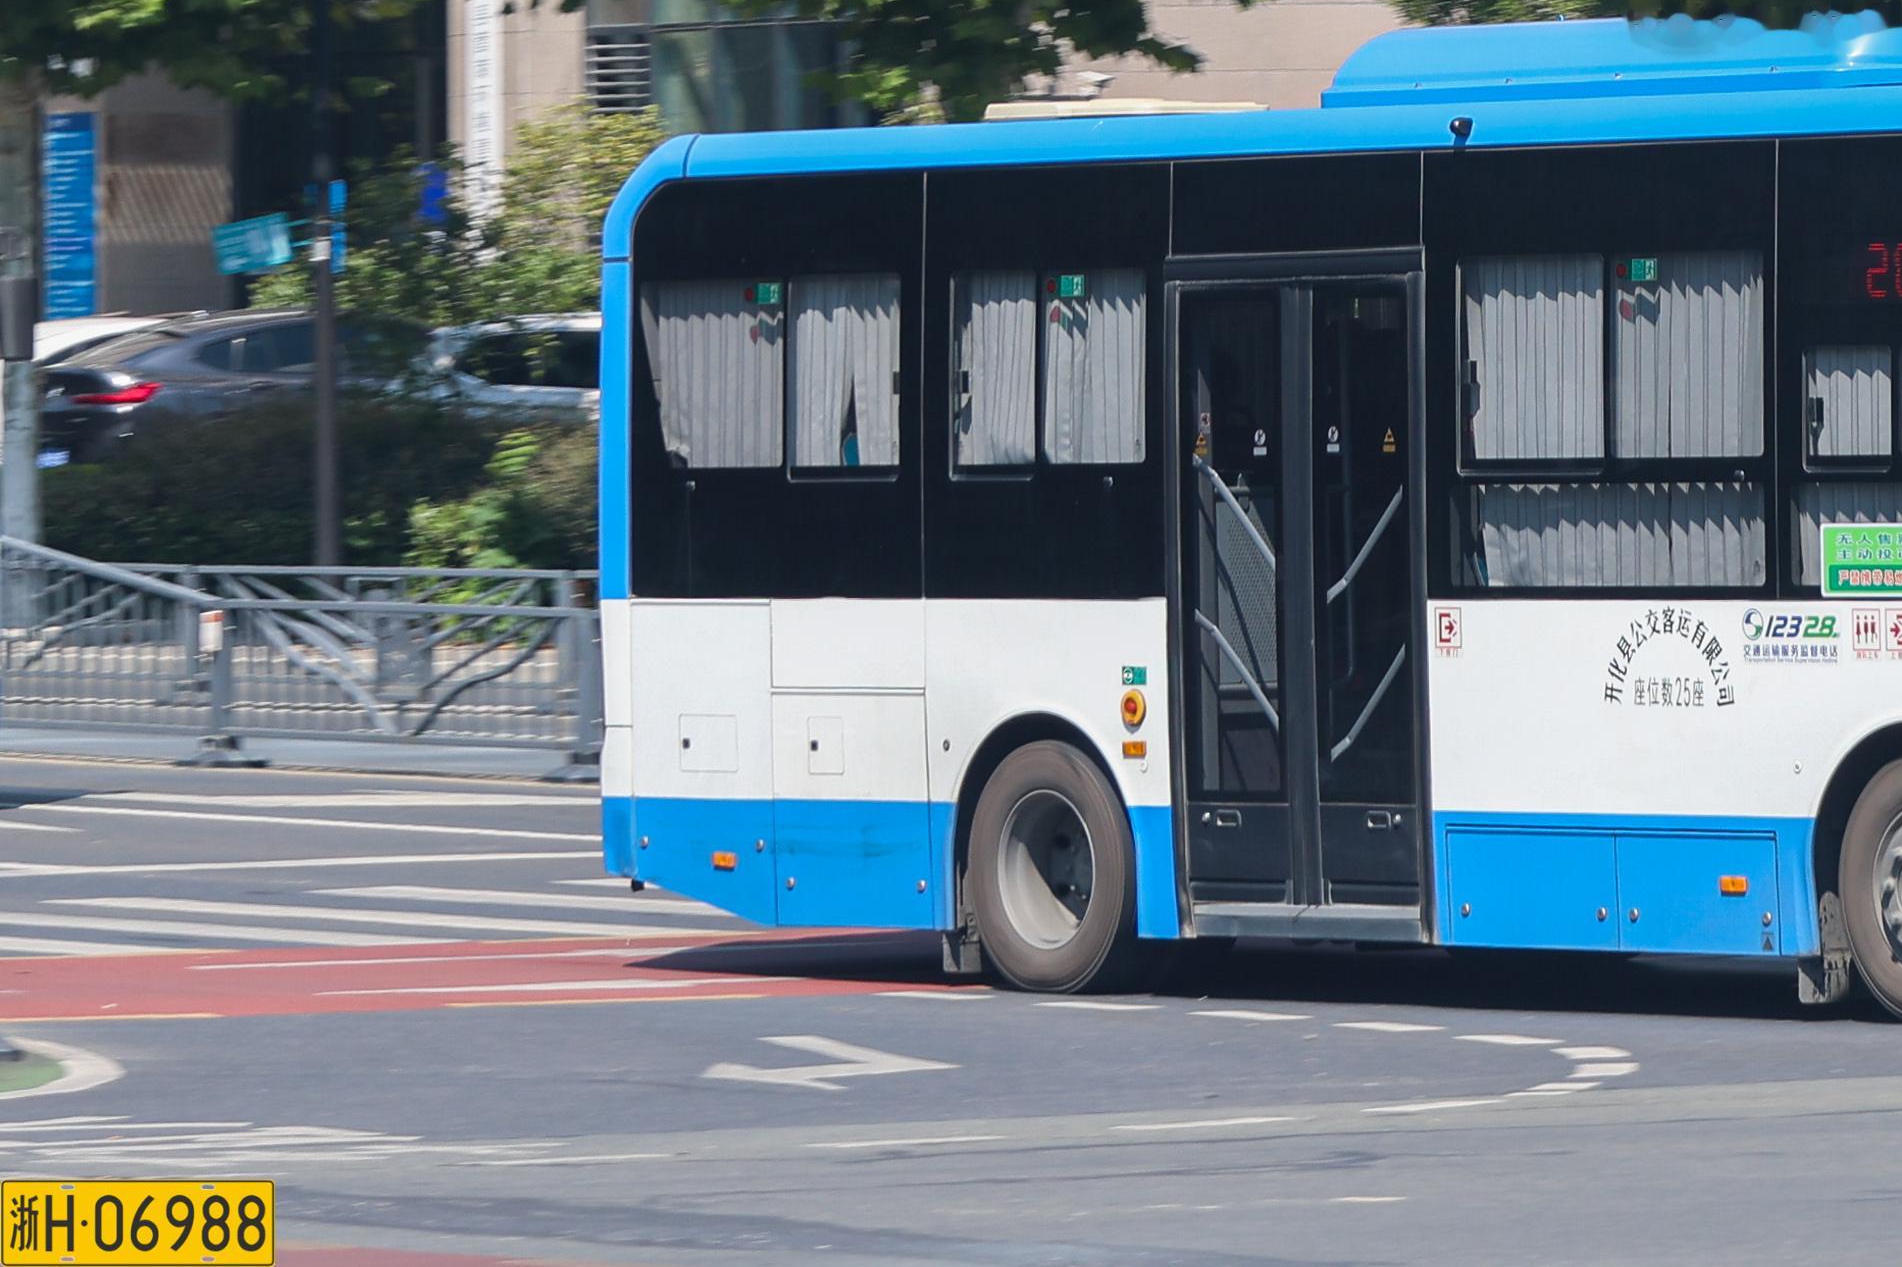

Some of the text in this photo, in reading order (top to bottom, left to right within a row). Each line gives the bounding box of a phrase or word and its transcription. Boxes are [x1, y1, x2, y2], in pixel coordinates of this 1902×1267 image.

[1604, 605, 1735, 707] 开化县公交客运有限公司
[1744, 644, 1838, 658] 交通运输服务监督电话
[1634, 677, 1704, 707] 座位数25座
